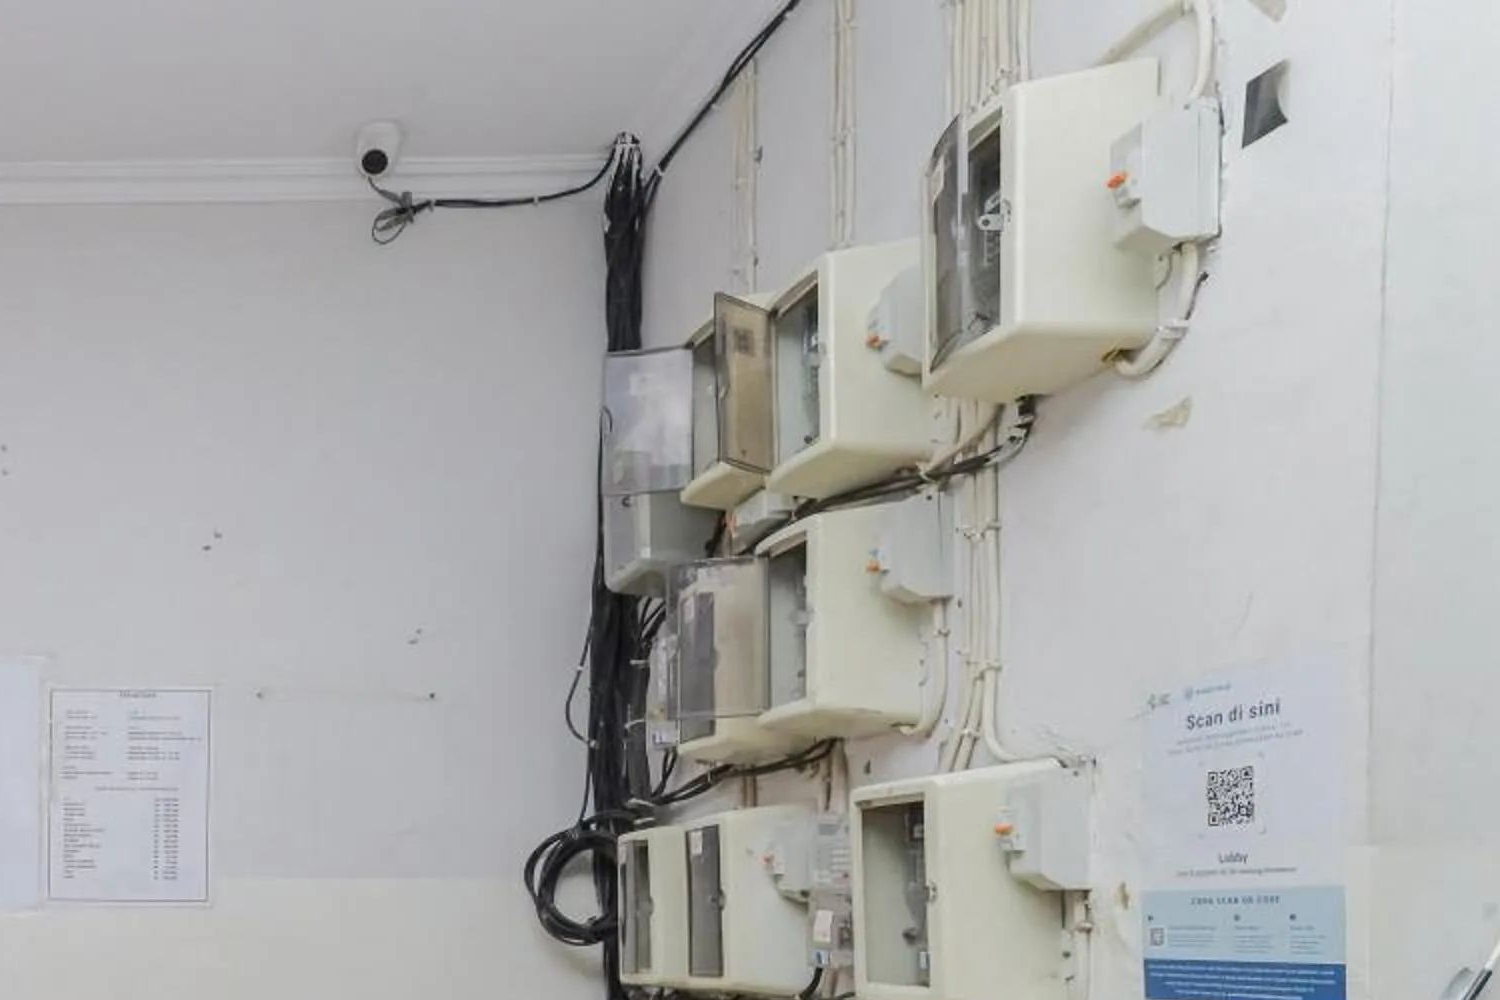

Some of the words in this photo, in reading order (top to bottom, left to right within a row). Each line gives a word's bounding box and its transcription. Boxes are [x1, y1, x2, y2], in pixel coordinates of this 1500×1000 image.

[1186, 711, 1224, 731] Scan
[1228, 703, 1243, 722] di
[1249, 696, 1280, 719] sini
